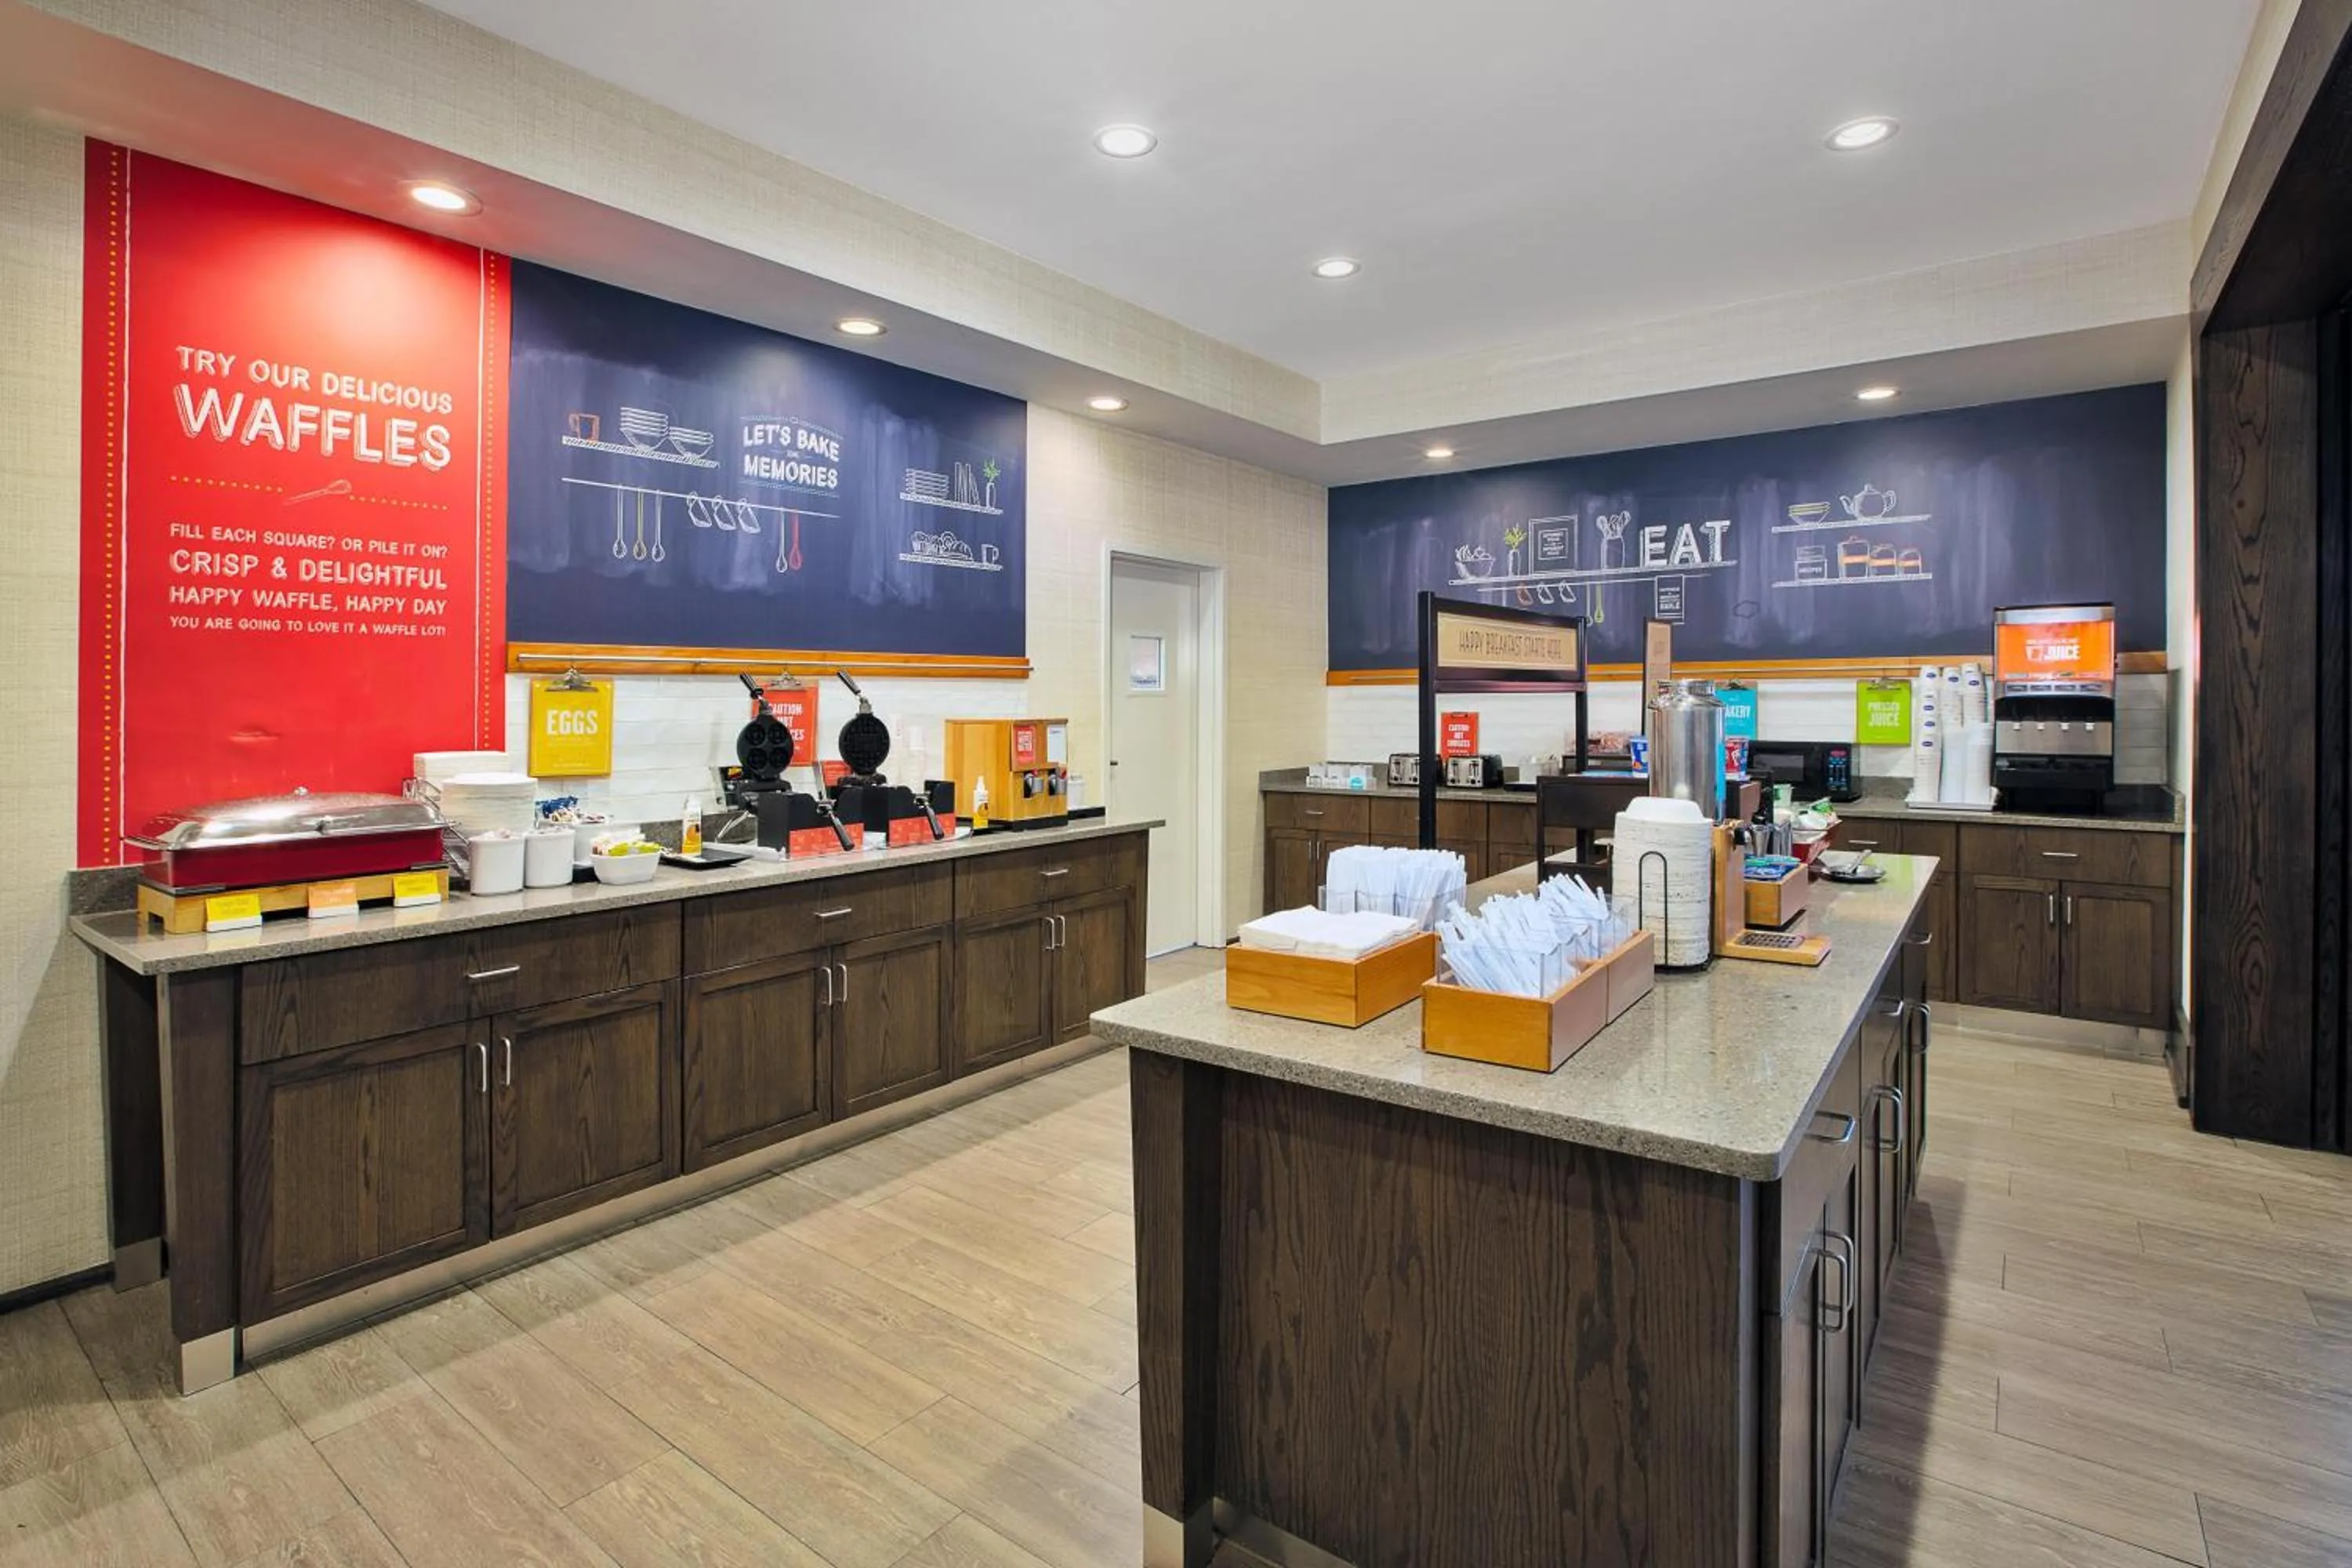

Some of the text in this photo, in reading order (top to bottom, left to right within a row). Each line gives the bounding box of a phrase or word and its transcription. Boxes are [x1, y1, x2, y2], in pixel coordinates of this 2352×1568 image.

[176, 346, 452, 414] TRY OUR DELICIOUS
[173, 383, 451, 471] WAFFLES
[742, 424, 840, 463] LET'S BAKE
[743, 455, 838, 489] MEMORIES
[170, 523, 448, 558] FILL EACH SQUARE? OR PILE IT ON?
[1639, 520, 1730, 567] EAT
[169, 549, 448, 590] CRISP & DELIGHTFUL
[169, 586, 447, 615] HAPPY WAFFLE, HAPPY DAY
[170, 615, 199, 628] YOU
[205, 617, 233, 630] ARE
[238, 618, 281, 631] GOING
[287, 620, 303, 632] TO
[307, 621, 339, 633] LOVE
[343, 622, 354, 634] IT
[359, 622, 368, 634] A
[372, 624, 418, 636] WAFFLE
[1458, 630, 1483, 654] HAPPY
[1485, 632, 1522, 656] BREAKFAST
[2044, 644, 2081, 660] JUICE
[546, 709, 598, 735] EGGS
[1869, 712, 1900, 728] JUICE
